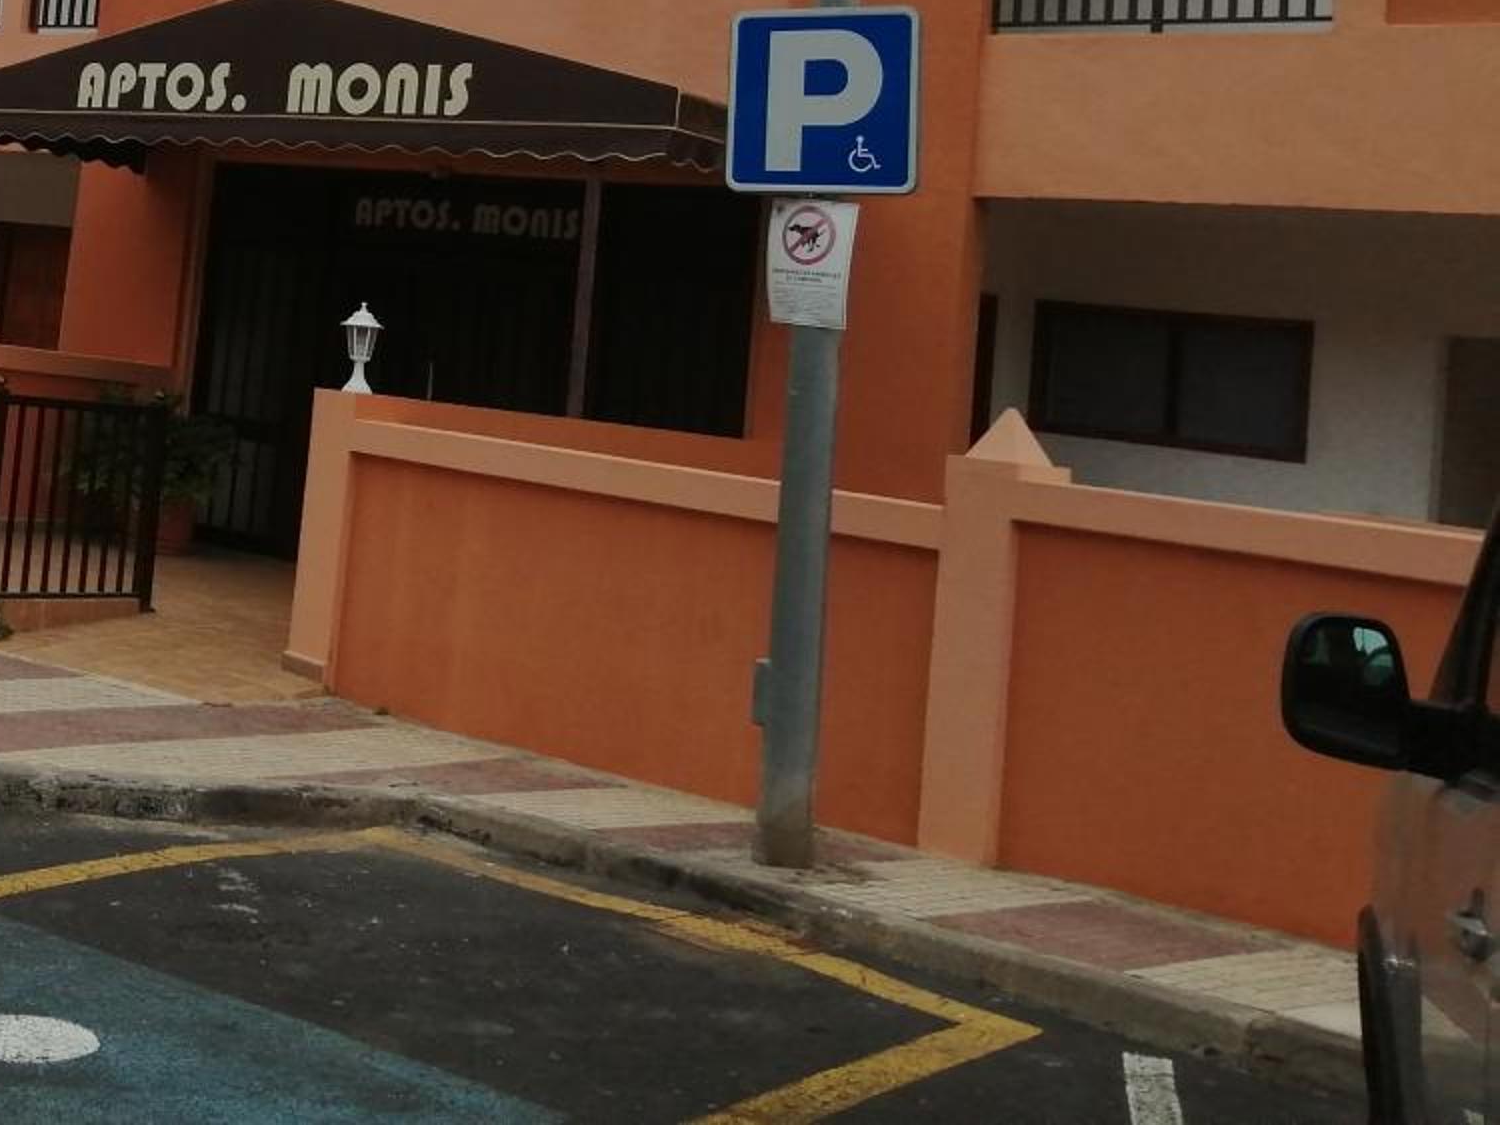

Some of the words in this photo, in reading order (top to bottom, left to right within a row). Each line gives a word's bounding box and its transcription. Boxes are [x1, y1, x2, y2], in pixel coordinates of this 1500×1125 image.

[76, 61, 248, 112] APTOS.
[286, 62, 474, 117] MONIS
[765, 29, 884, 172] P
[355, 197, 461, 231] APTOS.
[471, 202, 580, 240] MONIS
